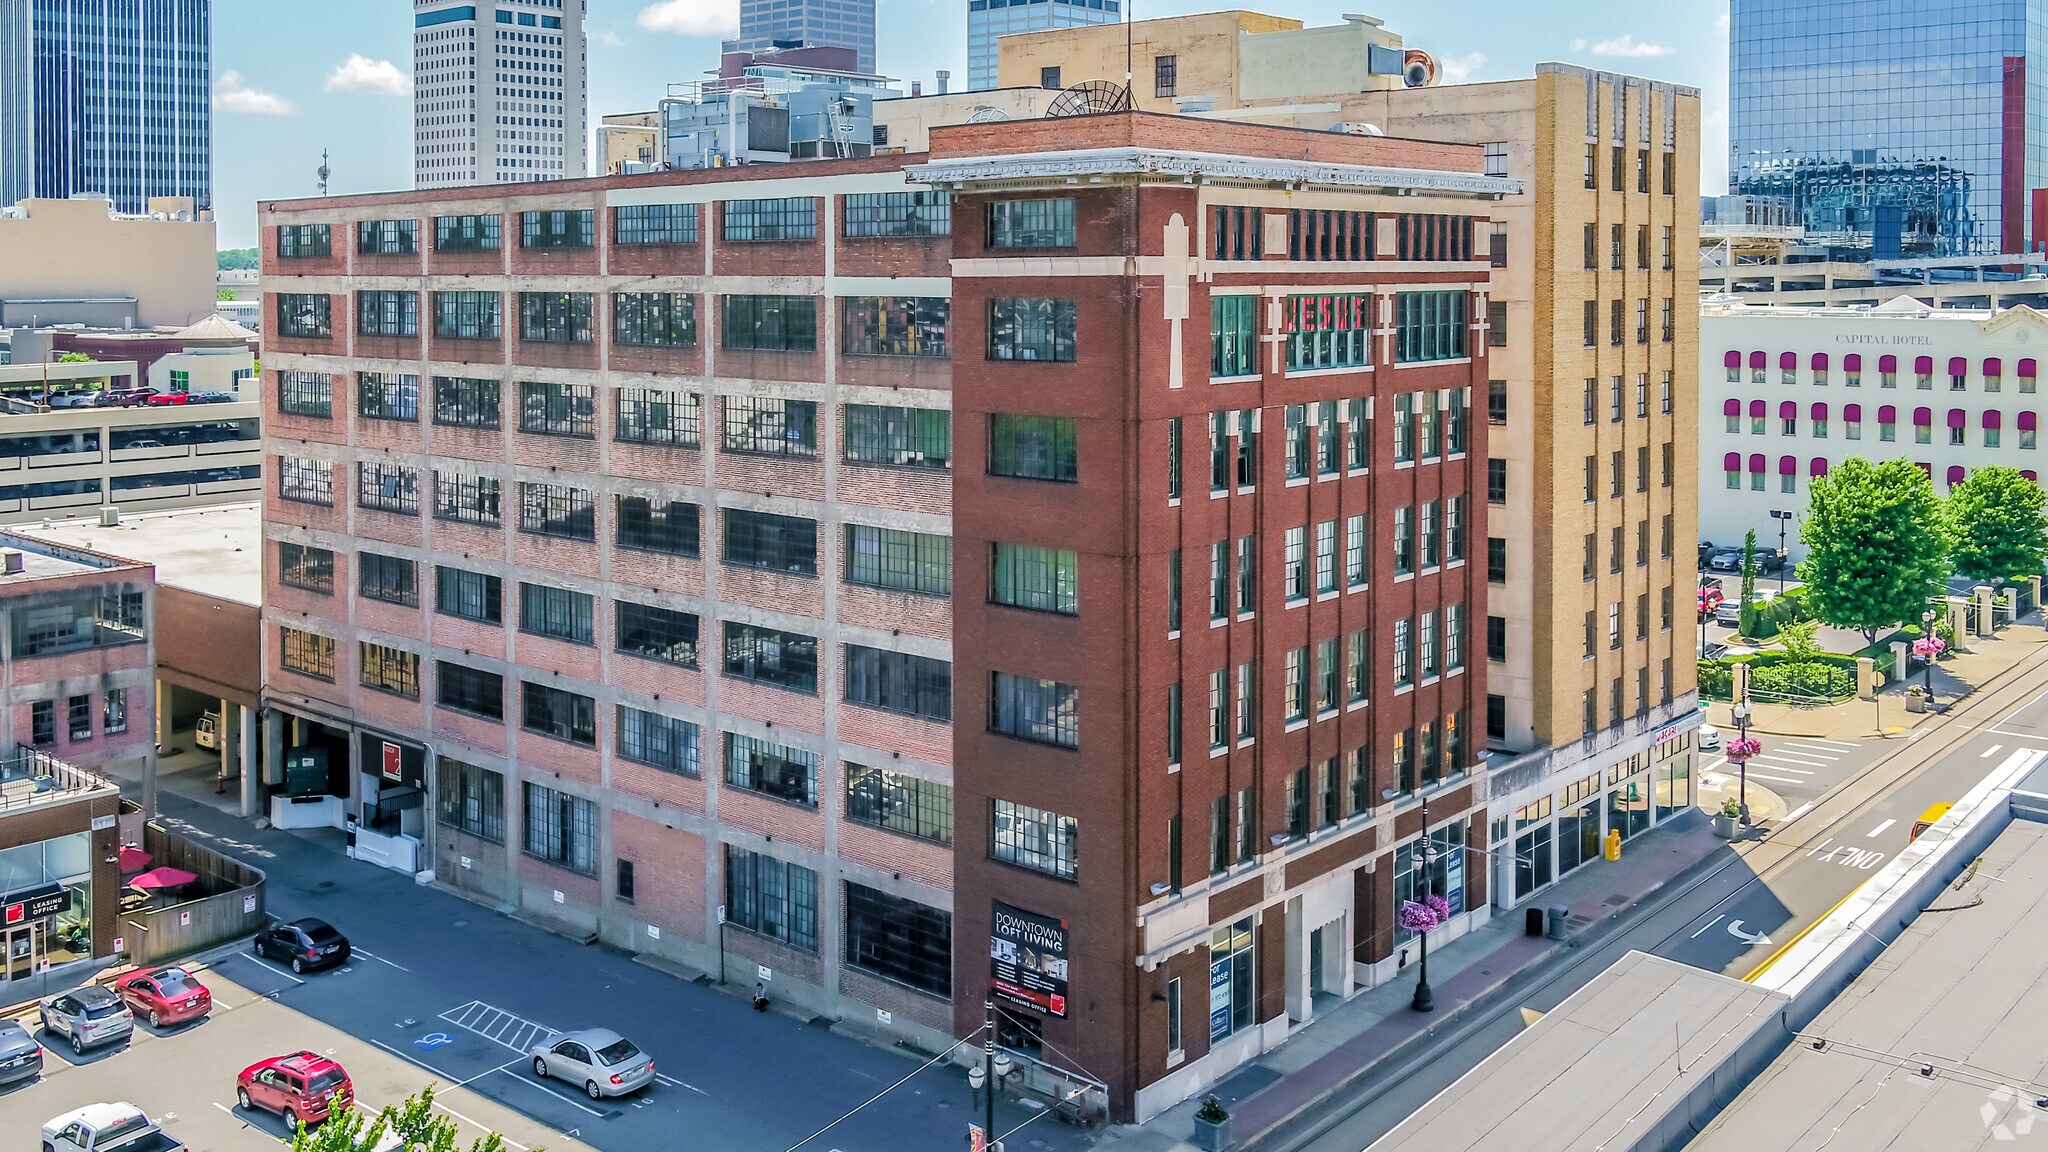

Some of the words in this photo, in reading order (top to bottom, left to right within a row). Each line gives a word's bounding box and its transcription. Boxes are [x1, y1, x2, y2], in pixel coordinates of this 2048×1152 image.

[1286, 297, 1364, 332] JESUS
[1836, 334, 1888, 345] CAPITAL
[1892, 335, 1932, 345] HOTEL
[1818, 846, 1885, 870] ONLY
[32, 897, 63, 909] LEASING
[32, 904, 58, 915] OFFICE
[996, 912, 1063, 942] DOWNTOWN
[996, 923, 1022, 939] LOFT
[1024, 931, 1063, 951] LIVING
[1211, 964, 1221, 974] or
[1010, 996, 1030, 1008] LEASING
[1031, 1003, 1047, 1013] OFFICE
